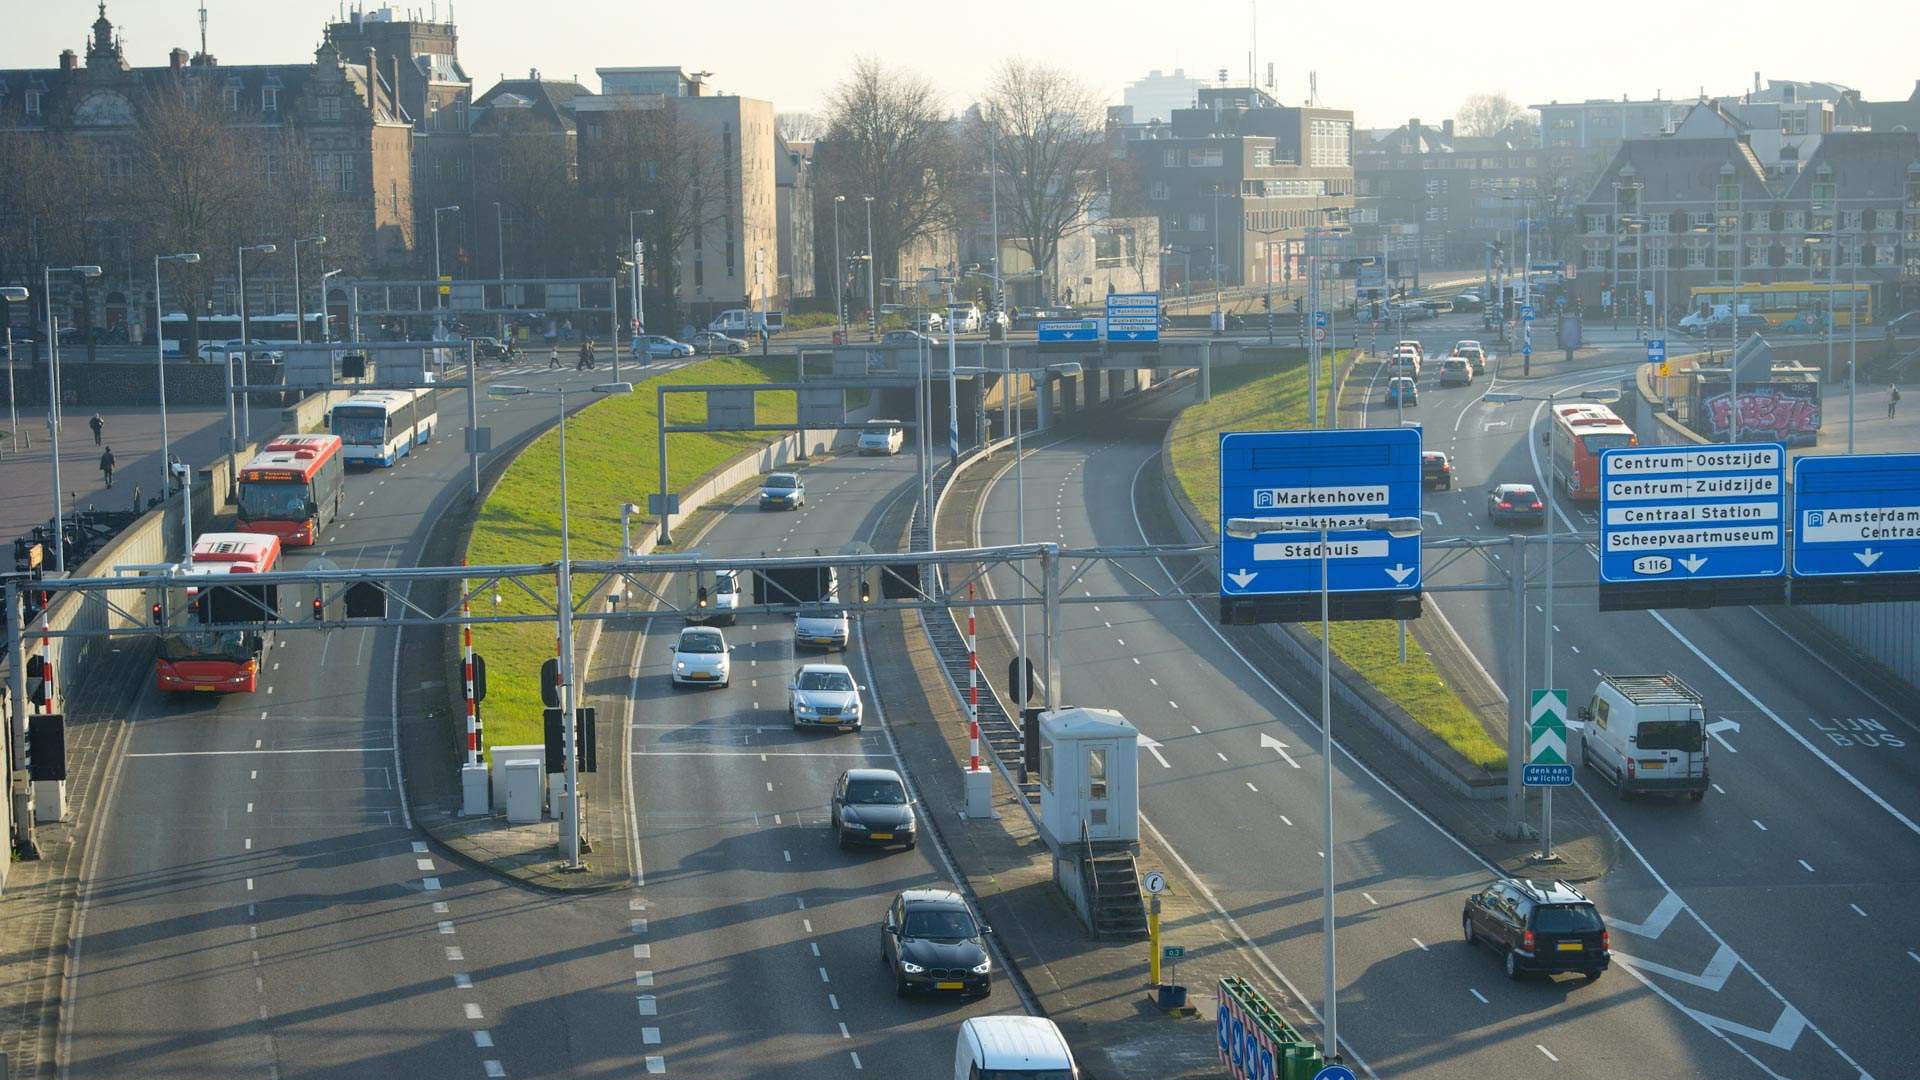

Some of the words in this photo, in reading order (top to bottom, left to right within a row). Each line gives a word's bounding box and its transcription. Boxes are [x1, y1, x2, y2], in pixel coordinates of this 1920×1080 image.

[1277, 490, 1385, 505] Markenhoven
[1625, 507, 1695, 521] Centraal
[1702, 505, 1761, 519] Station
[1827, 510, 1919, 523] Amsterdam
[1612, 529, 1774, 547] Scheepvaartmuseum
[1825, 733, 1905, 747] BUS
[1540, 774, 1570, 782] lichten
